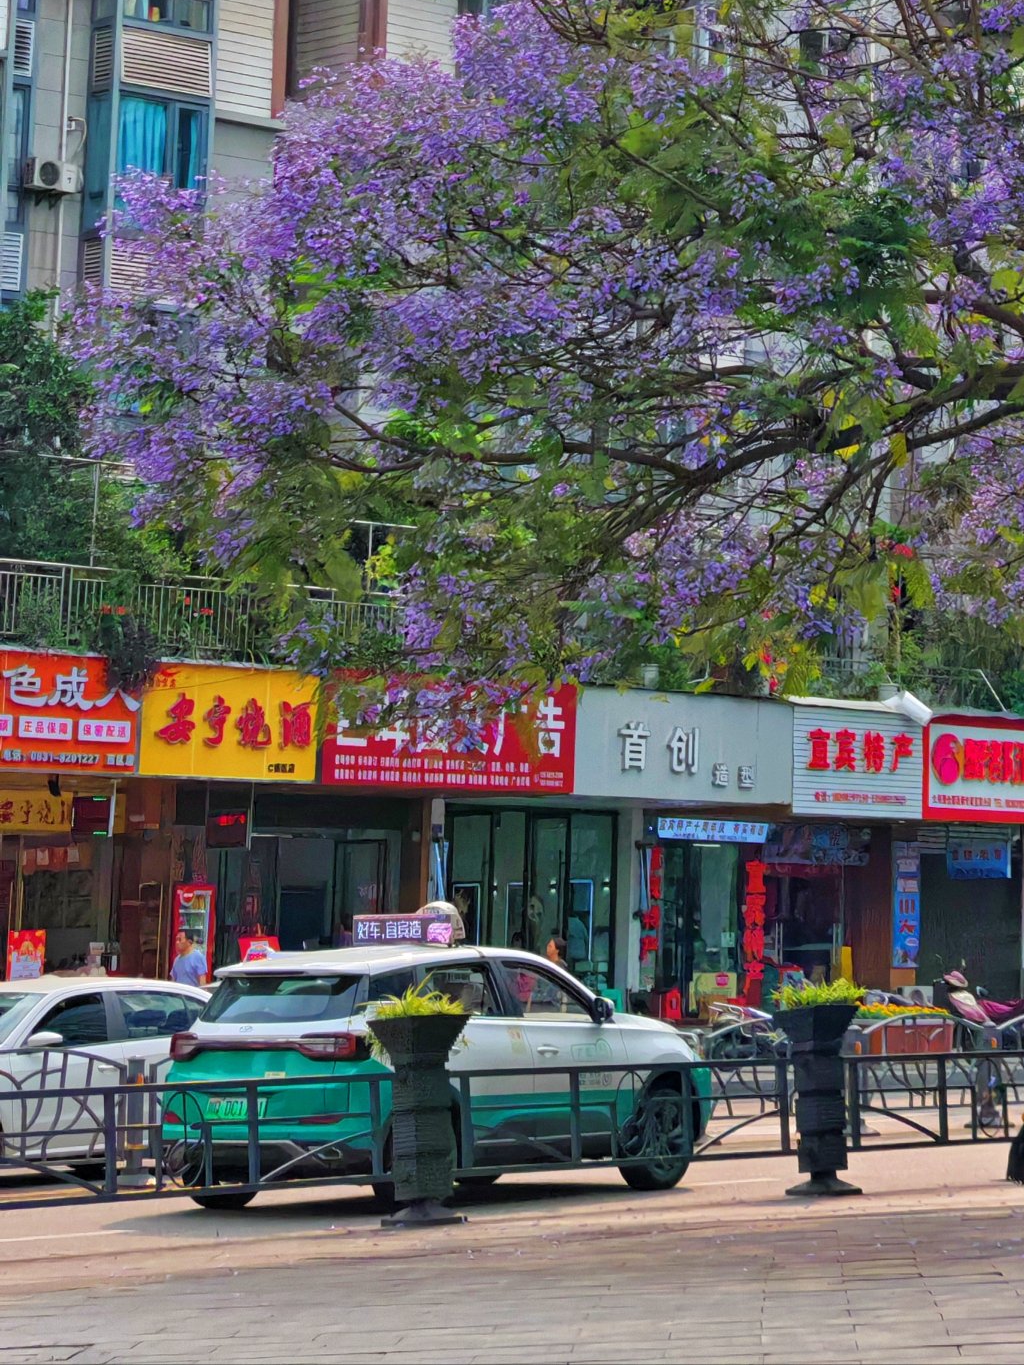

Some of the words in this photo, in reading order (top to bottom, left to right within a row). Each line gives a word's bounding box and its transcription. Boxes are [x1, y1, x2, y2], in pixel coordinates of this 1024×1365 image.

[618, 721, 700, 774] 首创
[806, 727, 914, 773] 宜宾特产
